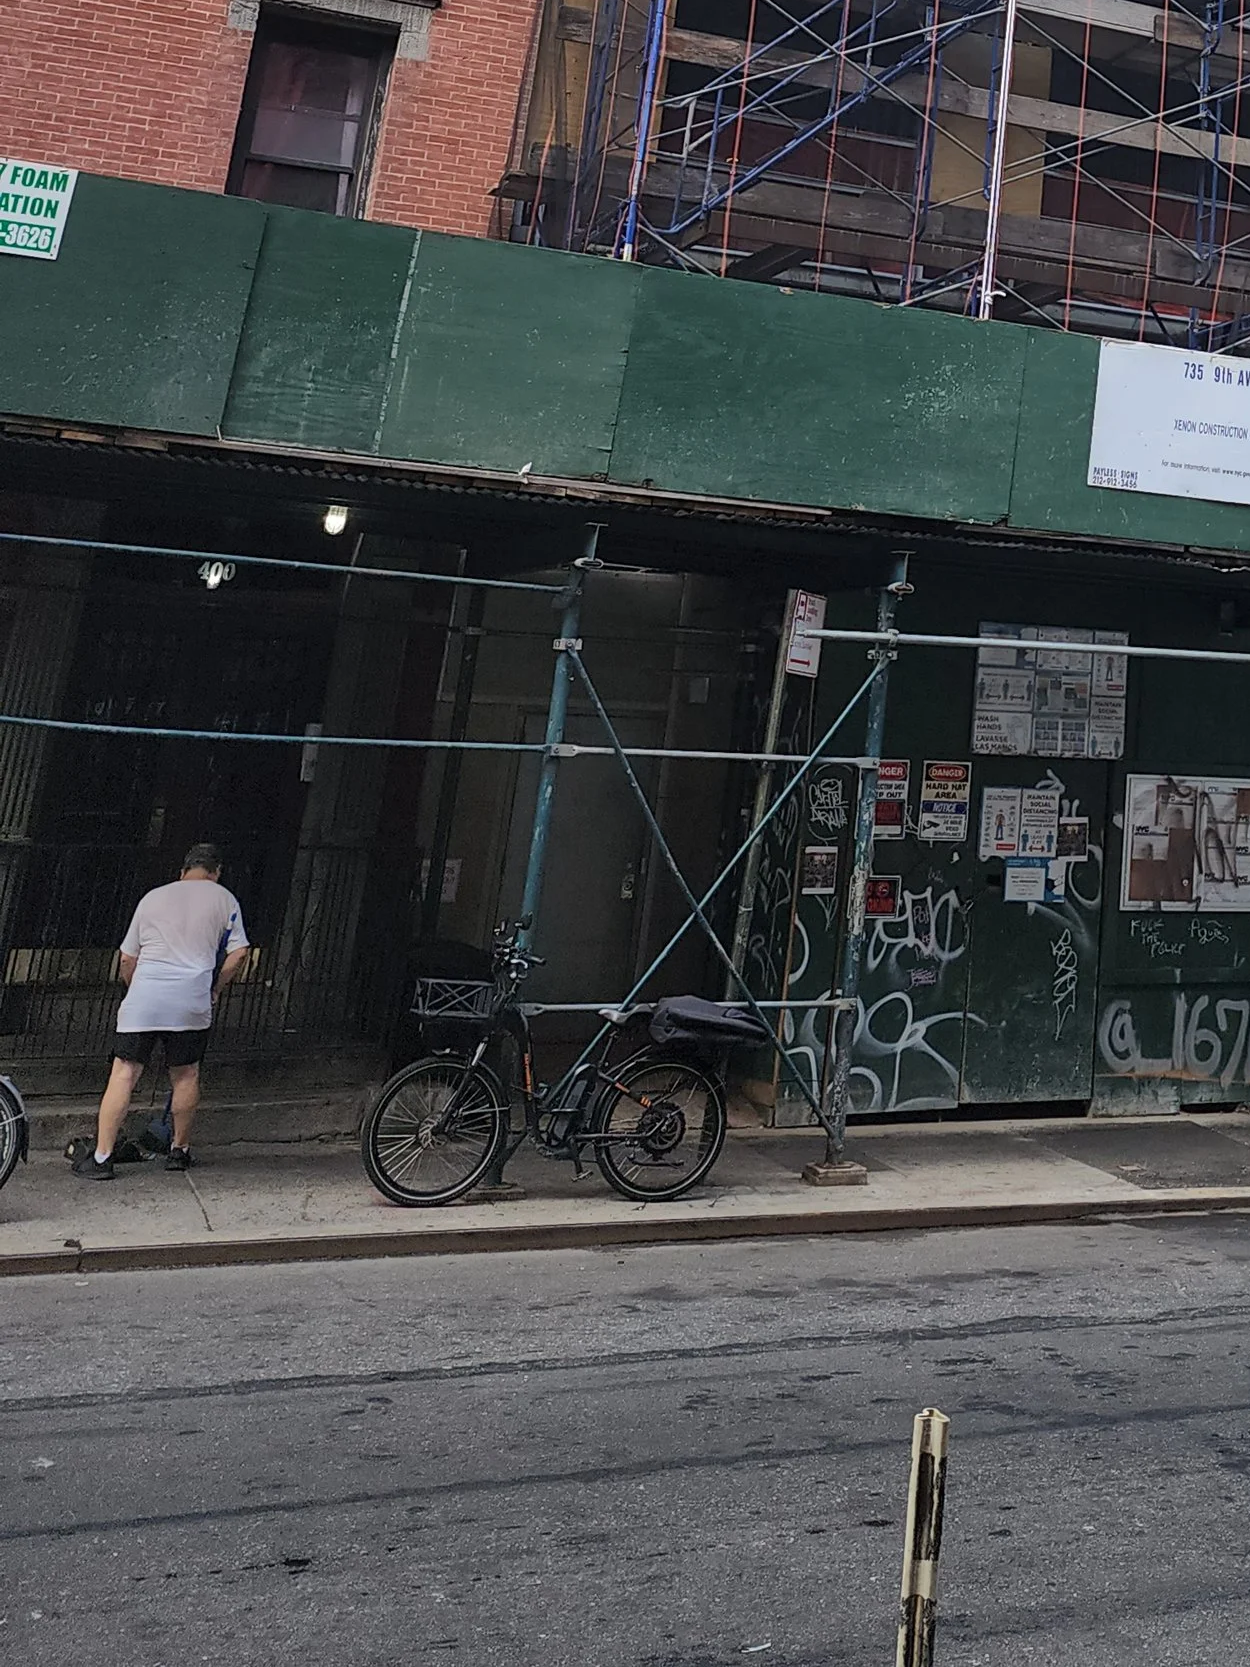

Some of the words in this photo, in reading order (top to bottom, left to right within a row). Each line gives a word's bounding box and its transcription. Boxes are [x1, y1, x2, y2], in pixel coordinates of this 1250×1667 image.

[10, 165, 69, 192] FOAM
[0, 223, 52, 250] -3626
[1184, 362, 1204, 380] 735
[1214, 367, 1232, 384] 9th
[1174, 419, 1197, 433] XENON
[1199, 422, 1249, 441] CONSTRUCTION
[1093, 467, 1118, 478] PAYLESS
[1120, 470, 1139, 481] SIGNS
[197, 561, 236, 581] 400
[878, 766, 904, 776] NGER
[932, 767, 964, 777] DANGER
